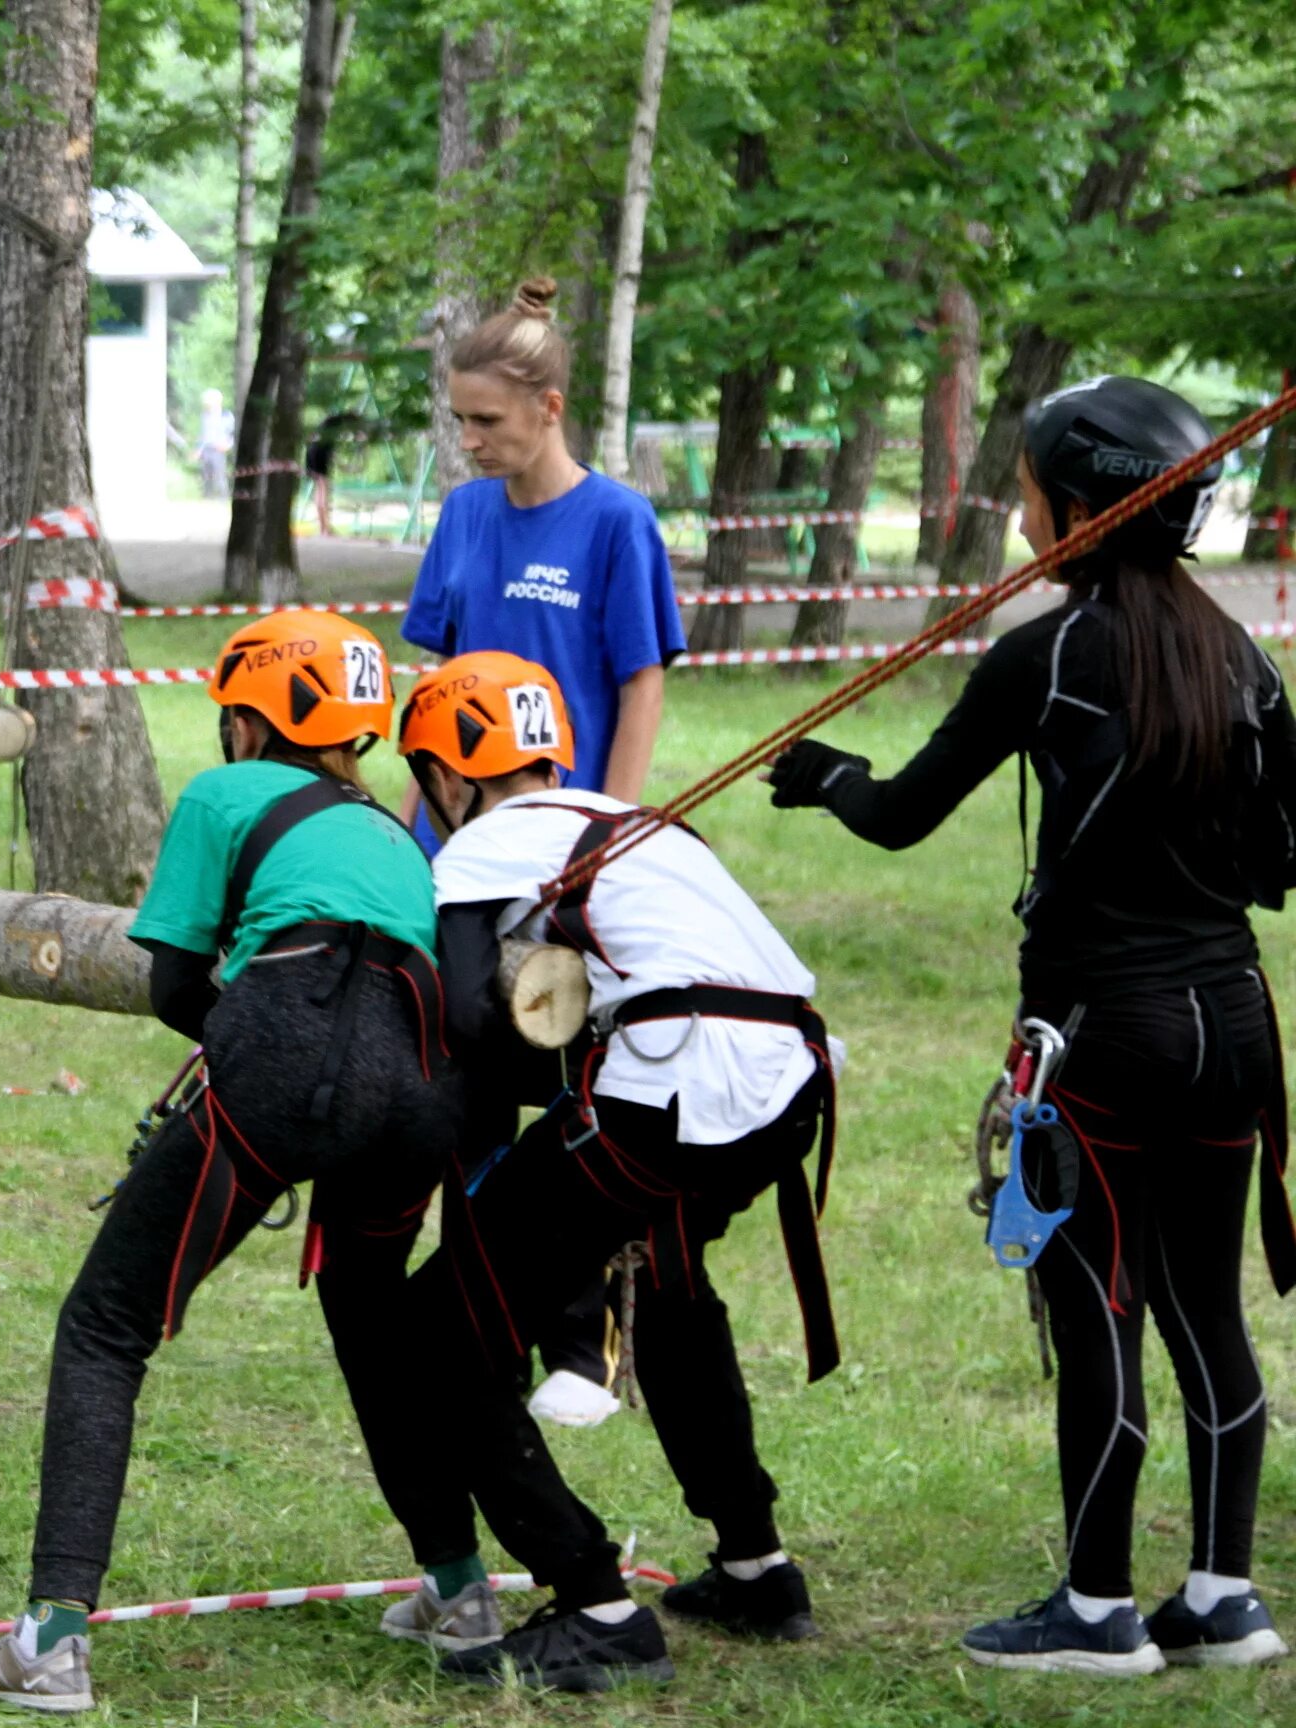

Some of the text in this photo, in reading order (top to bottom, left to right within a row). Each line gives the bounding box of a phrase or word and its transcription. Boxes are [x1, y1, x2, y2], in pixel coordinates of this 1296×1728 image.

[524, 564, 570, 585] МЧС
[505, 582, 581, 609] РОССИИ
[244, 640, 317, 673] VENTO
[351, 646, 379, 699] 26
[415, 674, 479, 718] VENTO
[517, 691, 553, 746] 22
